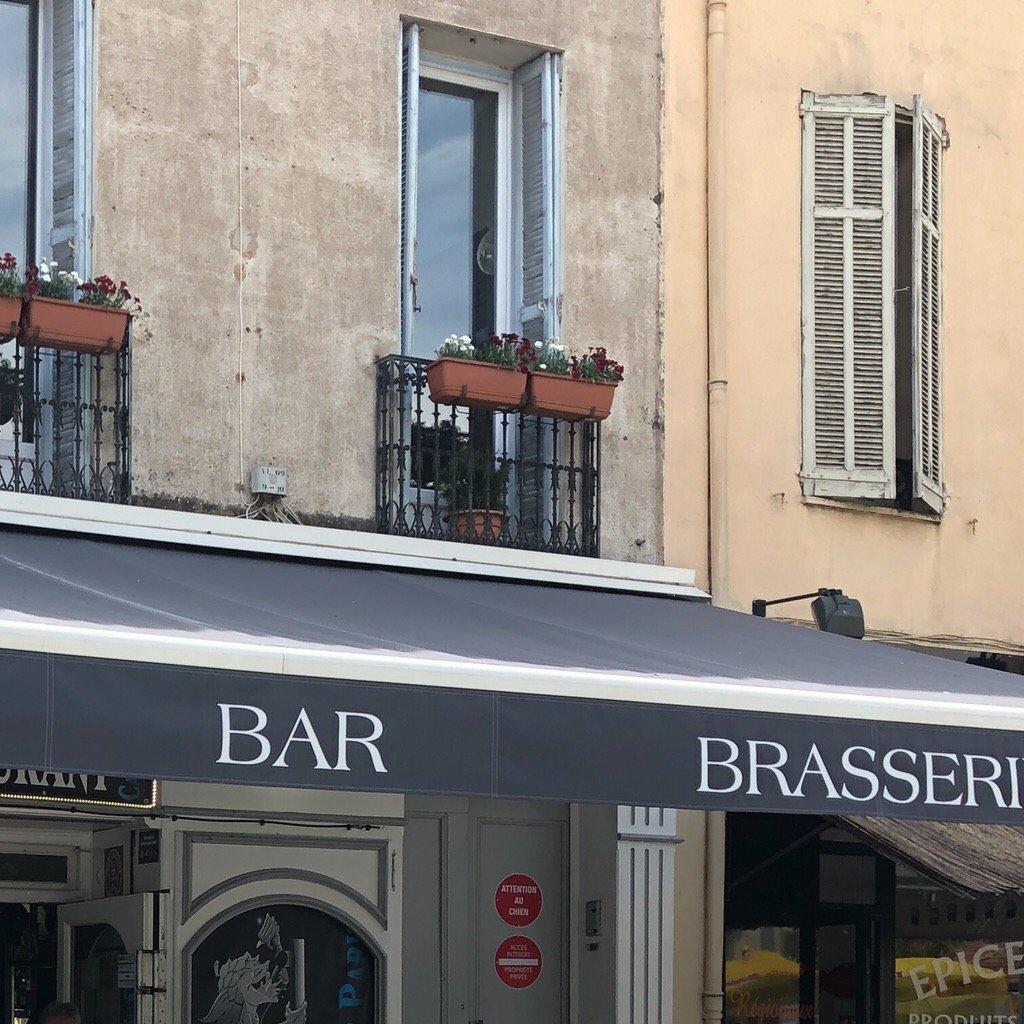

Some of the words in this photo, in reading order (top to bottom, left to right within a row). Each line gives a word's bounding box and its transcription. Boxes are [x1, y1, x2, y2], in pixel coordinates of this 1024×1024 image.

[215, 703, 388, 773] BAR
[696, 736, 1023, 809] BRASSERI
[501, 884, 537, 894] ATTENTION
[508, 907, 529, 916] CHIEN
[514, 896, 524, 905] AU
[338, 935, 366, 1009] PARI
[908, 940, 1024, 1001] EPICE
